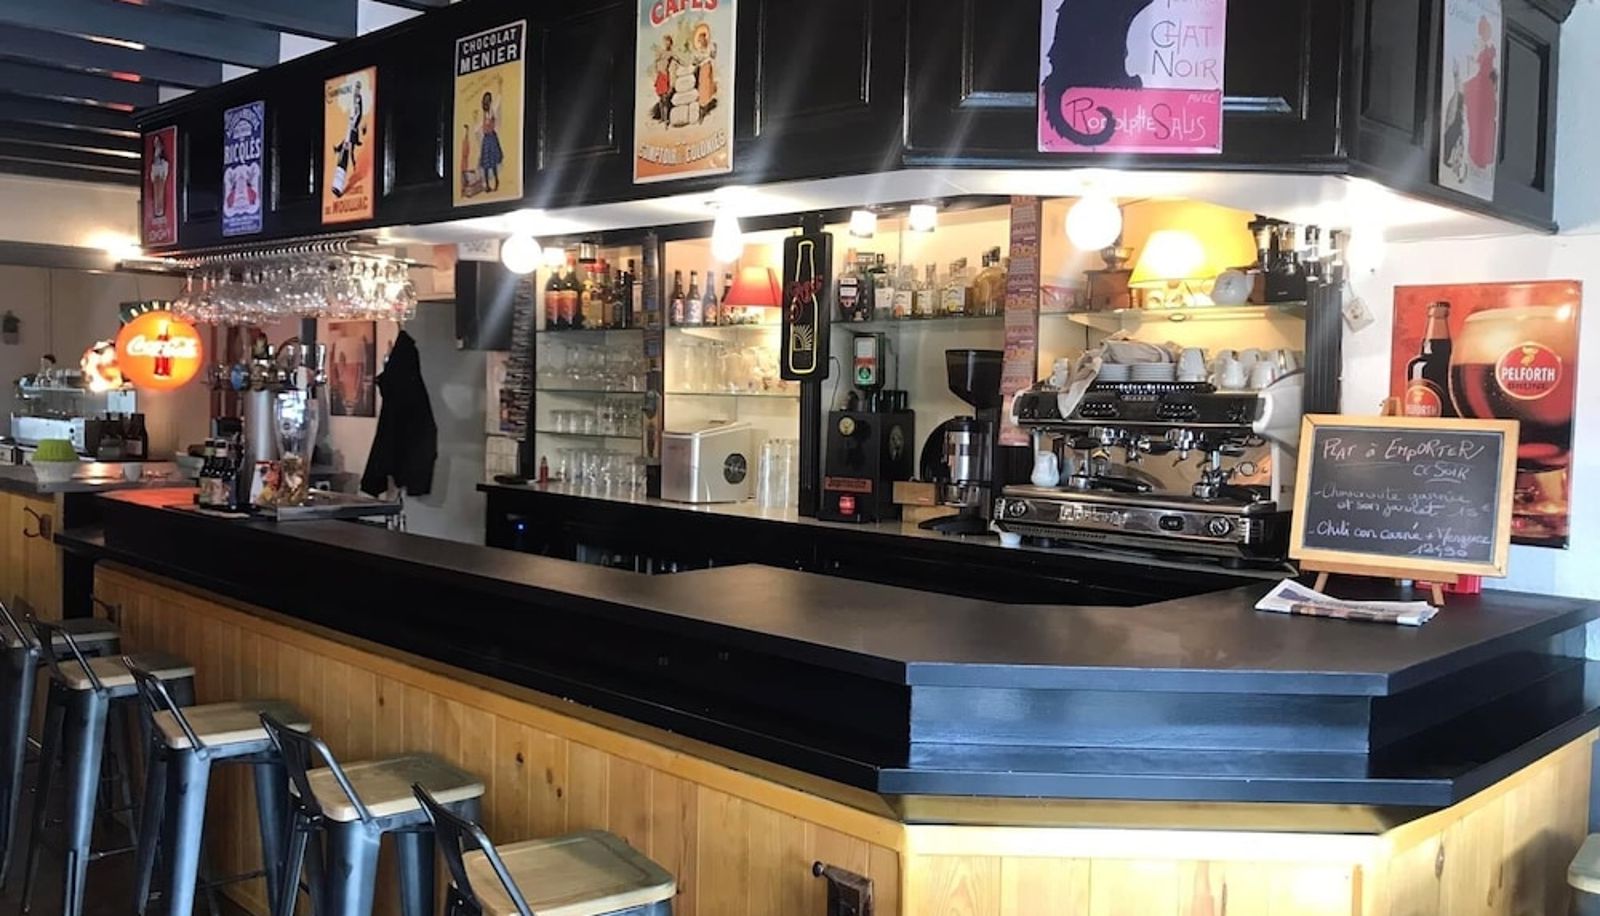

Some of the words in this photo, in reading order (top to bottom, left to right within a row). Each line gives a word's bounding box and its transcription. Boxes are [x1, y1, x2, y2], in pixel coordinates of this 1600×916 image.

[462, 28, 517, 54] CHOCOLAT
[1151, 19, 1213, 54] CHAT
[460, 44, 518, 74] MENIER
[1152, 50, 1218, 83] NOIR
[1187, 93, 1215, 105] AVEC
[1501, 367, 1556, 382] PELFORTH
[1323, 438, 1357, 460] PLAT
[1356, 502, 1380, 511] son
[1317, 520, 1350, 537] Chili
[1354, 528, 1377, 538] con
